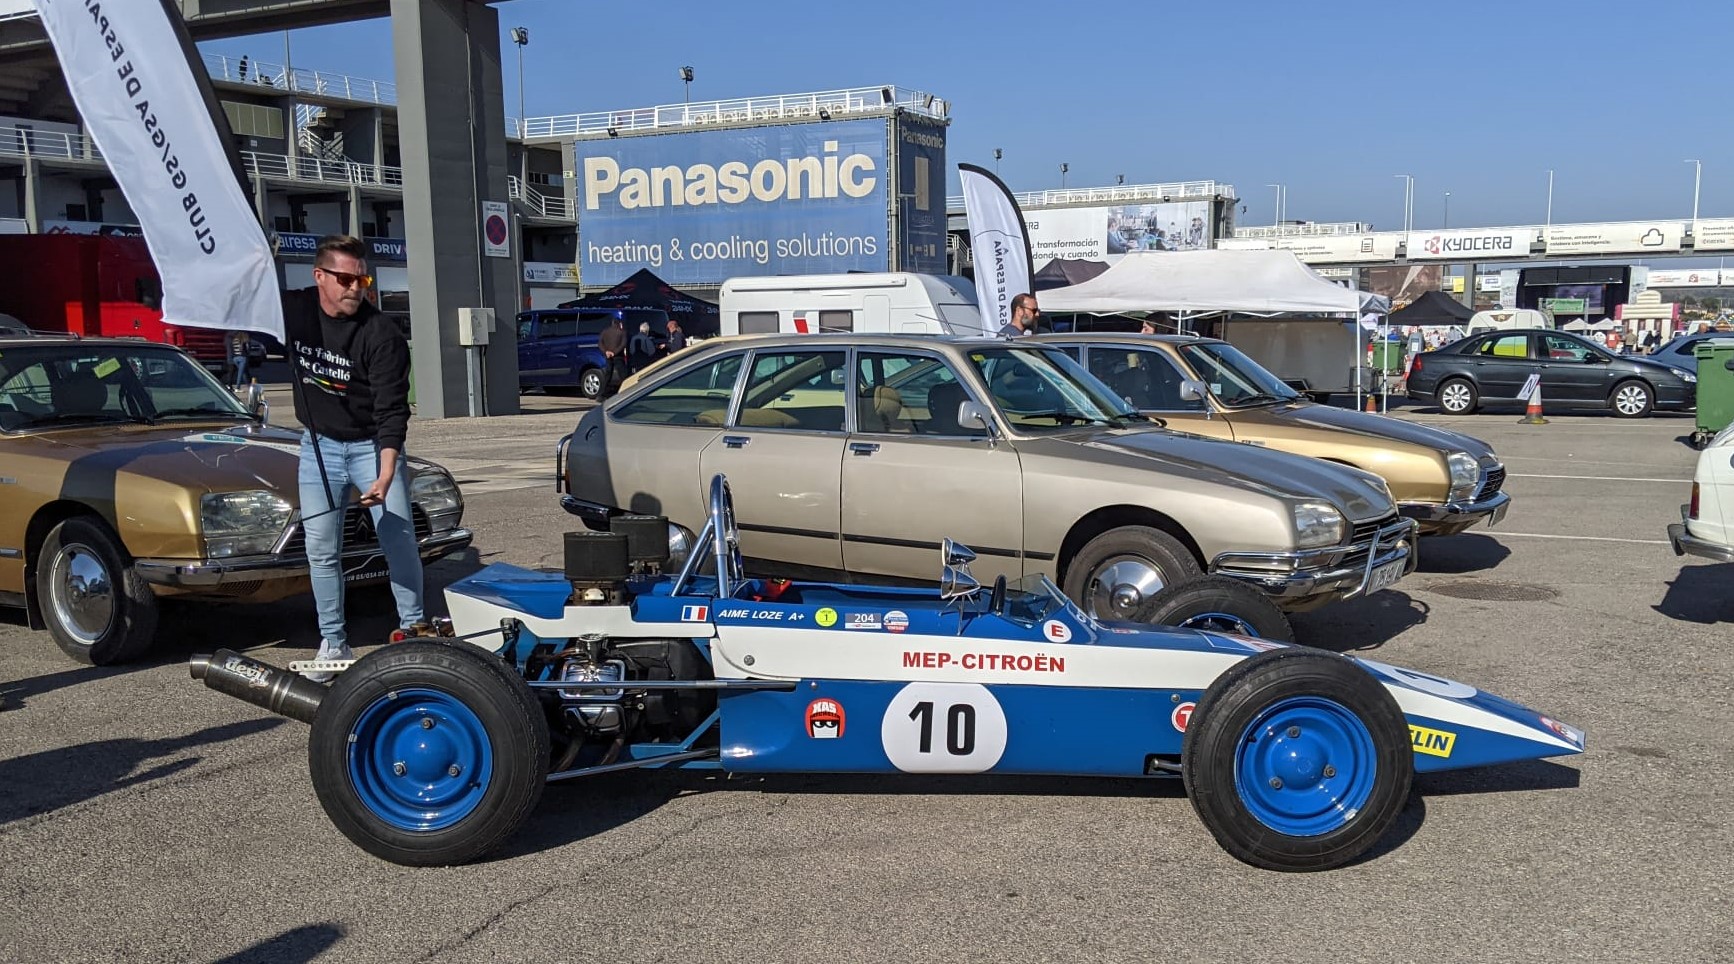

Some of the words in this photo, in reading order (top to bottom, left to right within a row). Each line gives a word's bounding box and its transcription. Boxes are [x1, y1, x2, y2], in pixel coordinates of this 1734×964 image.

[901, 125, 944, 149] Panasonic
[584, 141, 877, 210] Panasonic
[588, 240, 663, 266] heating
[669, 238, 684, 260] &
[690, 233, 769, 262] cooling
[776, 232, 877, 258] solutions
[1442, 236, 1512, 251] KYOCERA
[1068, 250, 1098, 258] cuando
[312, 362, 351, 381] Castelló
[718, 609, 750, 618] AIME
[752, 611, 783, 620] LOZE
[788, 613, 805, 621] A+
[854, 613, 875, 623] 204
[1051, 624, 1064, 637] E
[903, 652, 1065, 673] MEP-CITROËN
[908, 701, 976, 755] 10
